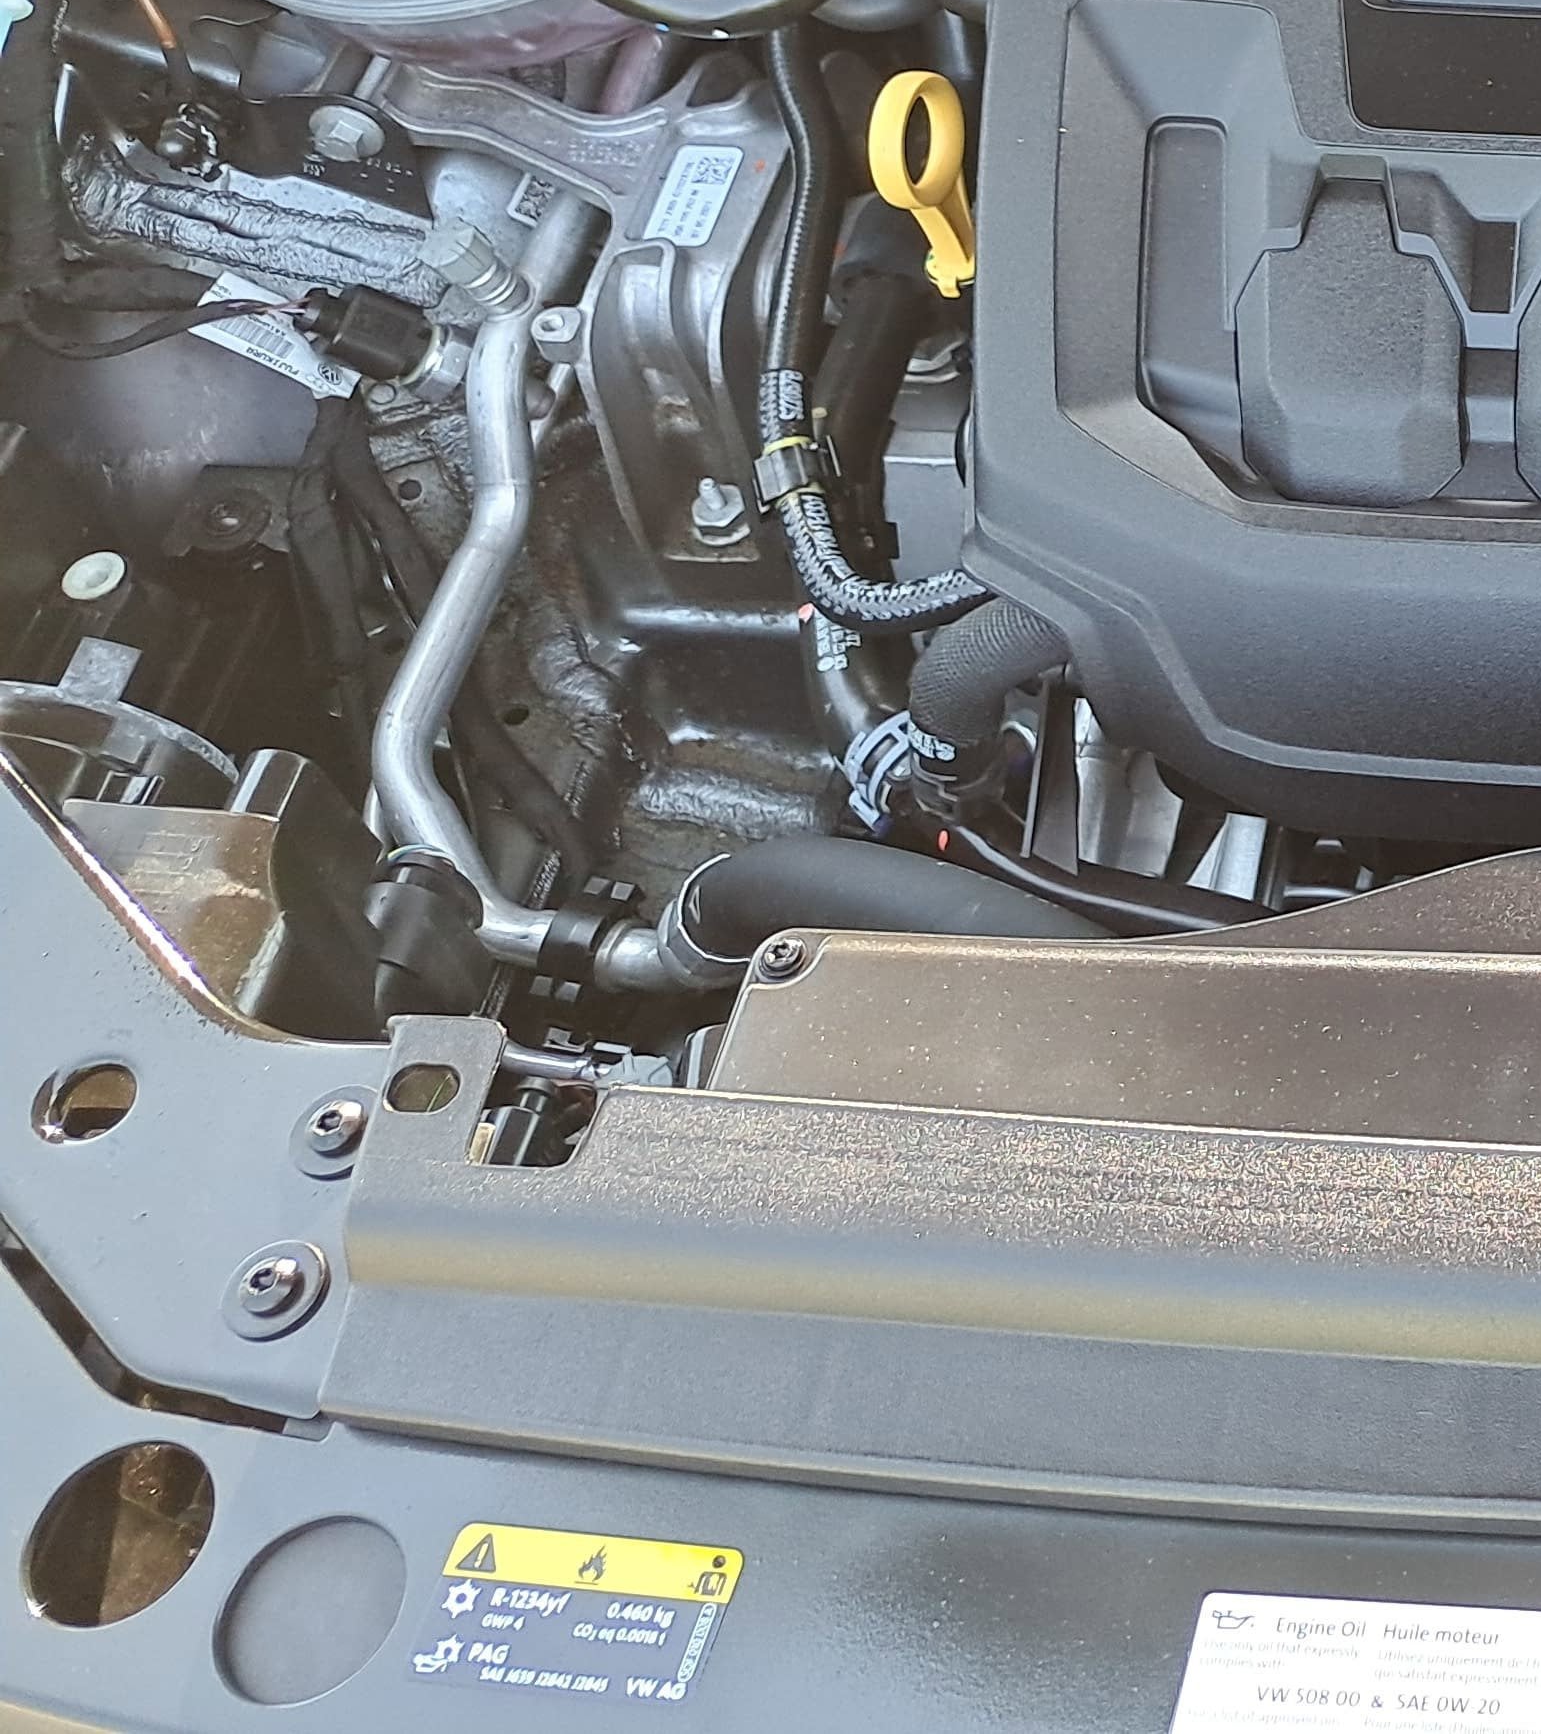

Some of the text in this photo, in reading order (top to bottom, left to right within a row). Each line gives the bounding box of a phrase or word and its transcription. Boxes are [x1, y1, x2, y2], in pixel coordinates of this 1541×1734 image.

[246, 346, 300, 376] FUJIKURA
[489, 1587, 676, 1628] R-1234yf 0.460 kg
[481, 1615, 511, 1629] GWP
[513, 1616, 525, 1630] 4
[1276, 1617, 1367, 1640] Engine Oil
[1382, 1623, 1501, 1645] Huile moteur
[467, 1643, 511, 1664] PAG
[625, 1677, 658, 1697] VW
[658, 1680, 687, 1700] AG
[1257, 1685, 1290, 1703] VW
[1296, 1687, 1331, 1705] 508
[1335, 1689, 1361, 1707] 00
[1370, 1694, 1384, 1709] &
[1396, 1693, 1429, 1712] SAE
